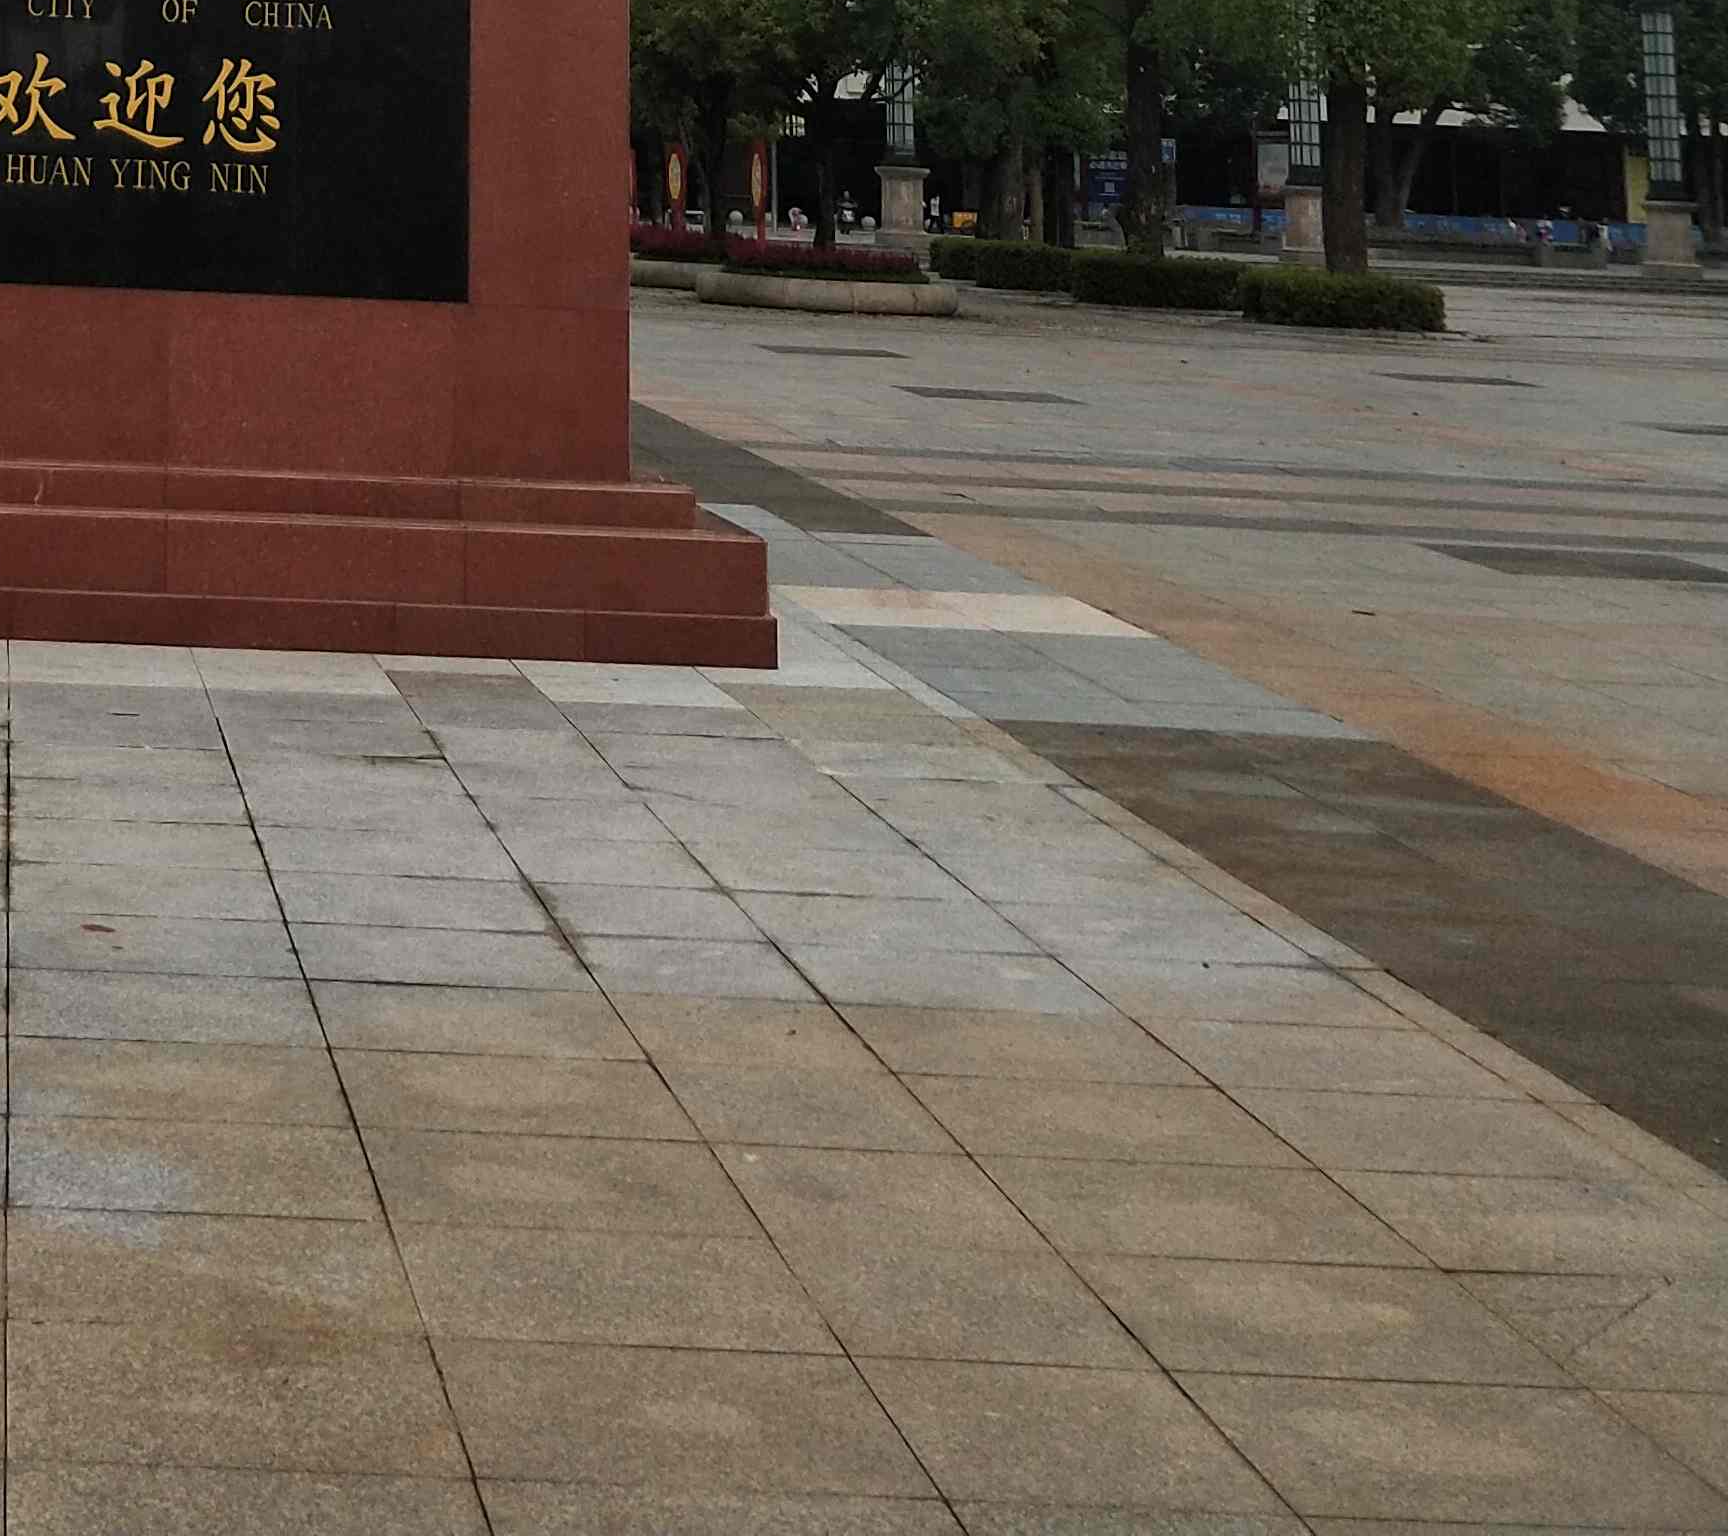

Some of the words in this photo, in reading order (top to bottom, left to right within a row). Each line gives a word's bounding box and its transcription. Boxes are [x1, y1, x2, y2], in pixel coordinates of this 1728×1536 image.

[244, 1, 335, 29] CHINA
[5, 155, 94, 186] HUAN
[111, 158, 192, 190] YING
[210, 162, 270, 193] NIN
